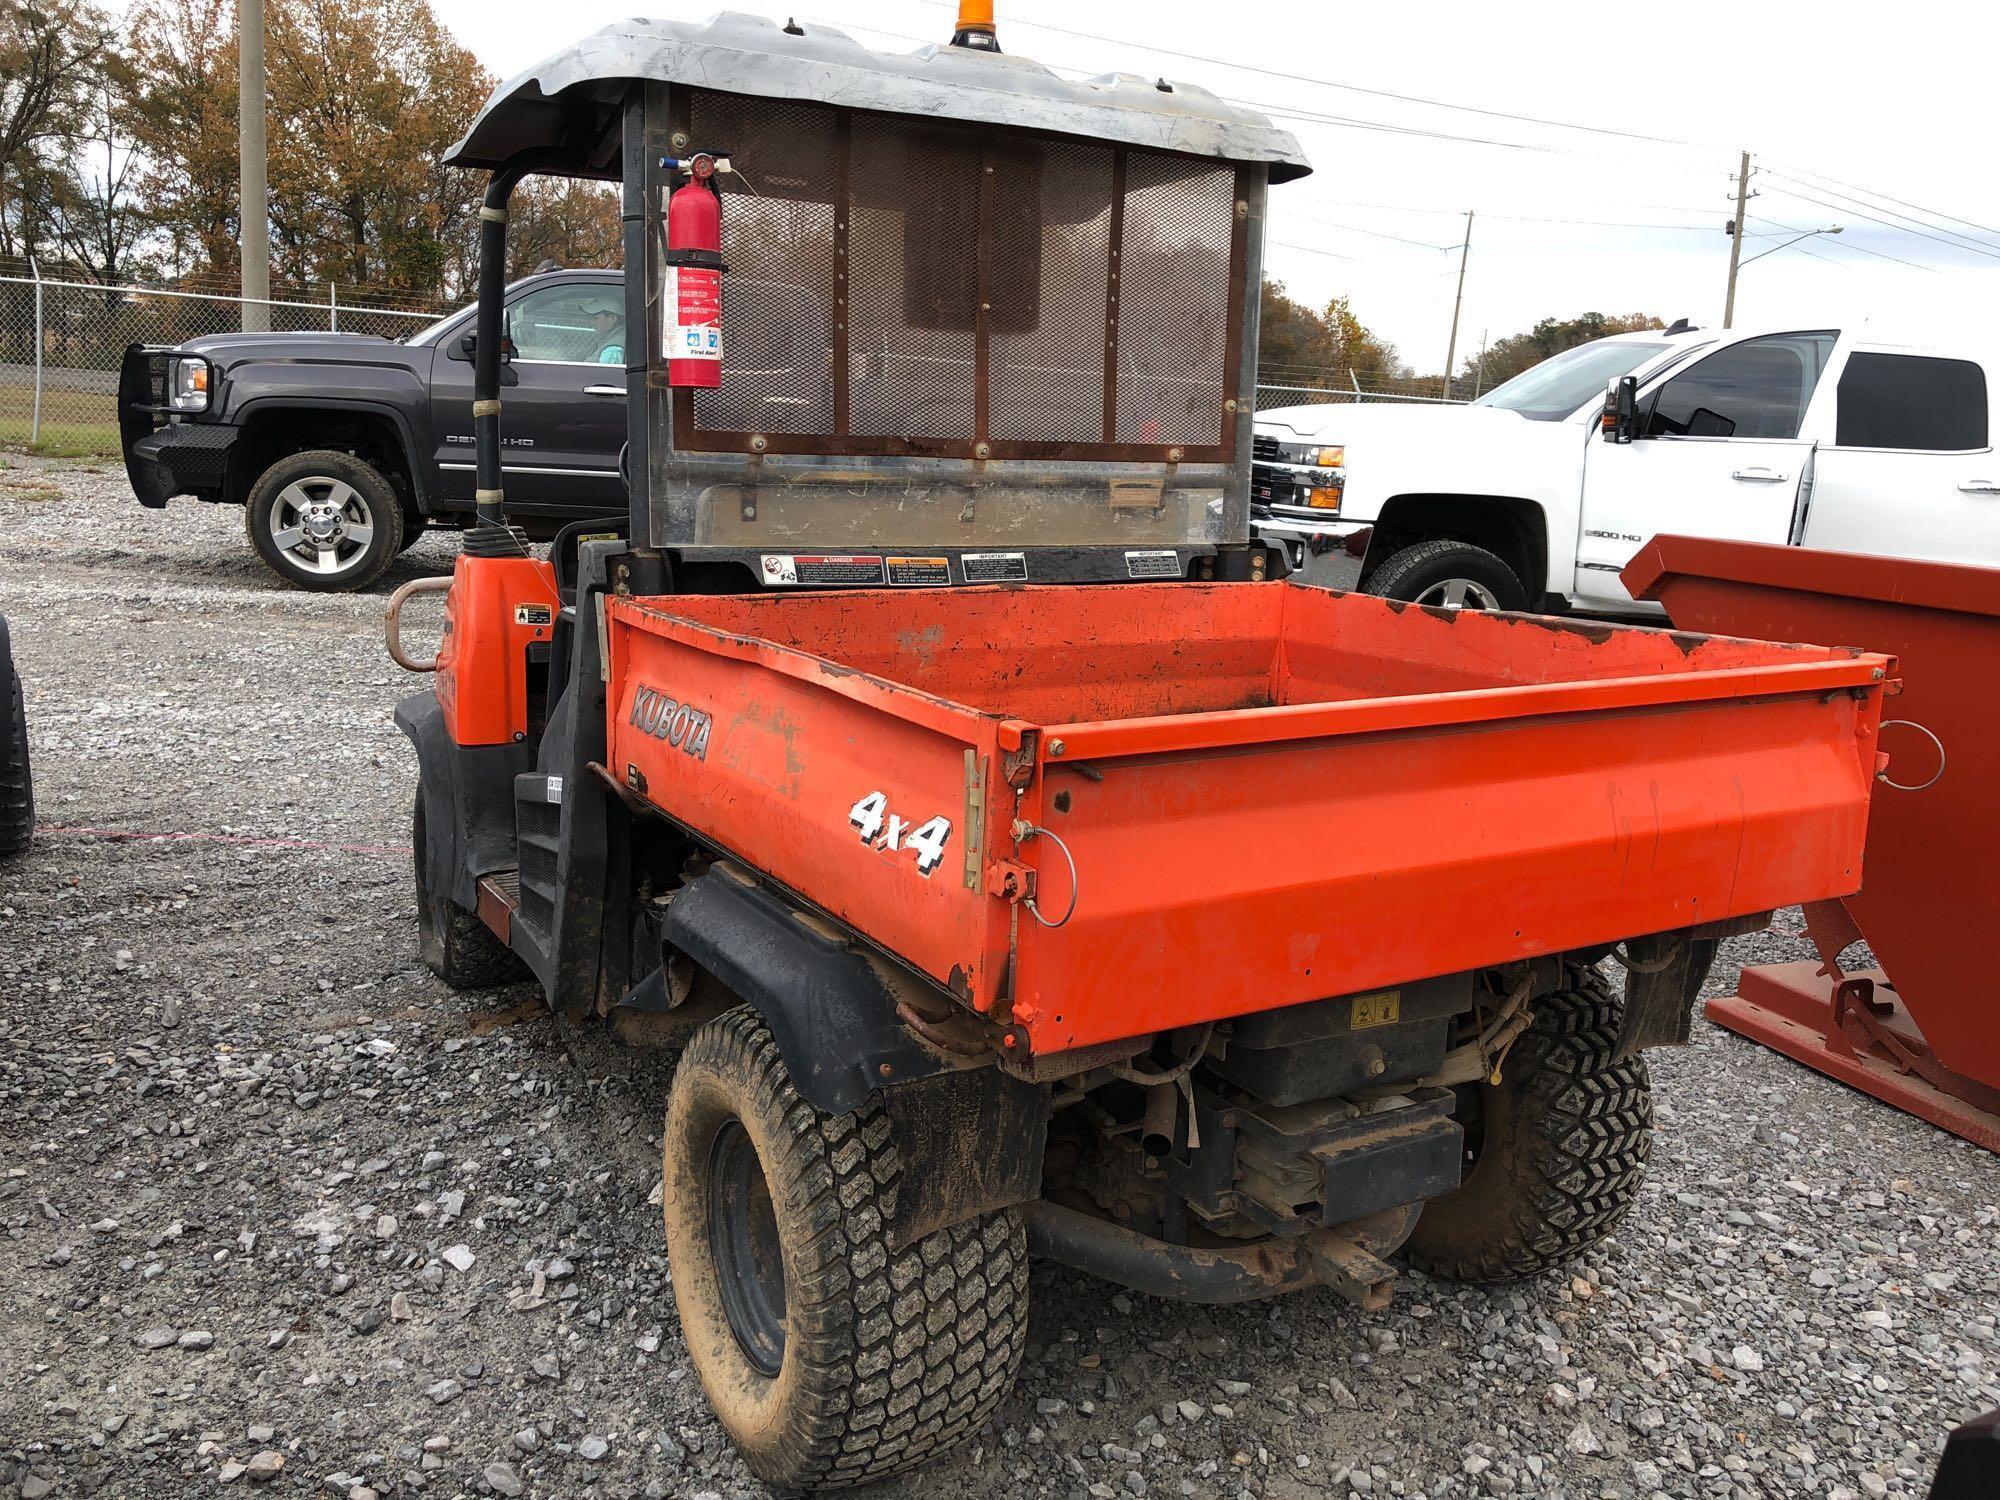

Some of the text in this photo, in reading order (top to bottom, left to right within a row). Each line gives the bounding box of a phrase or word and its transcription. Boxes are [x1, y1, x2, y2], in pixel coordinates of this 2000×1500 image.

[446, 435, 534, 446] DENI HD
[1622, 534, 1642, 542] HD
[629, 683, 712, 761] KUBOTA
[848, 790, 953, 878] 4x4
